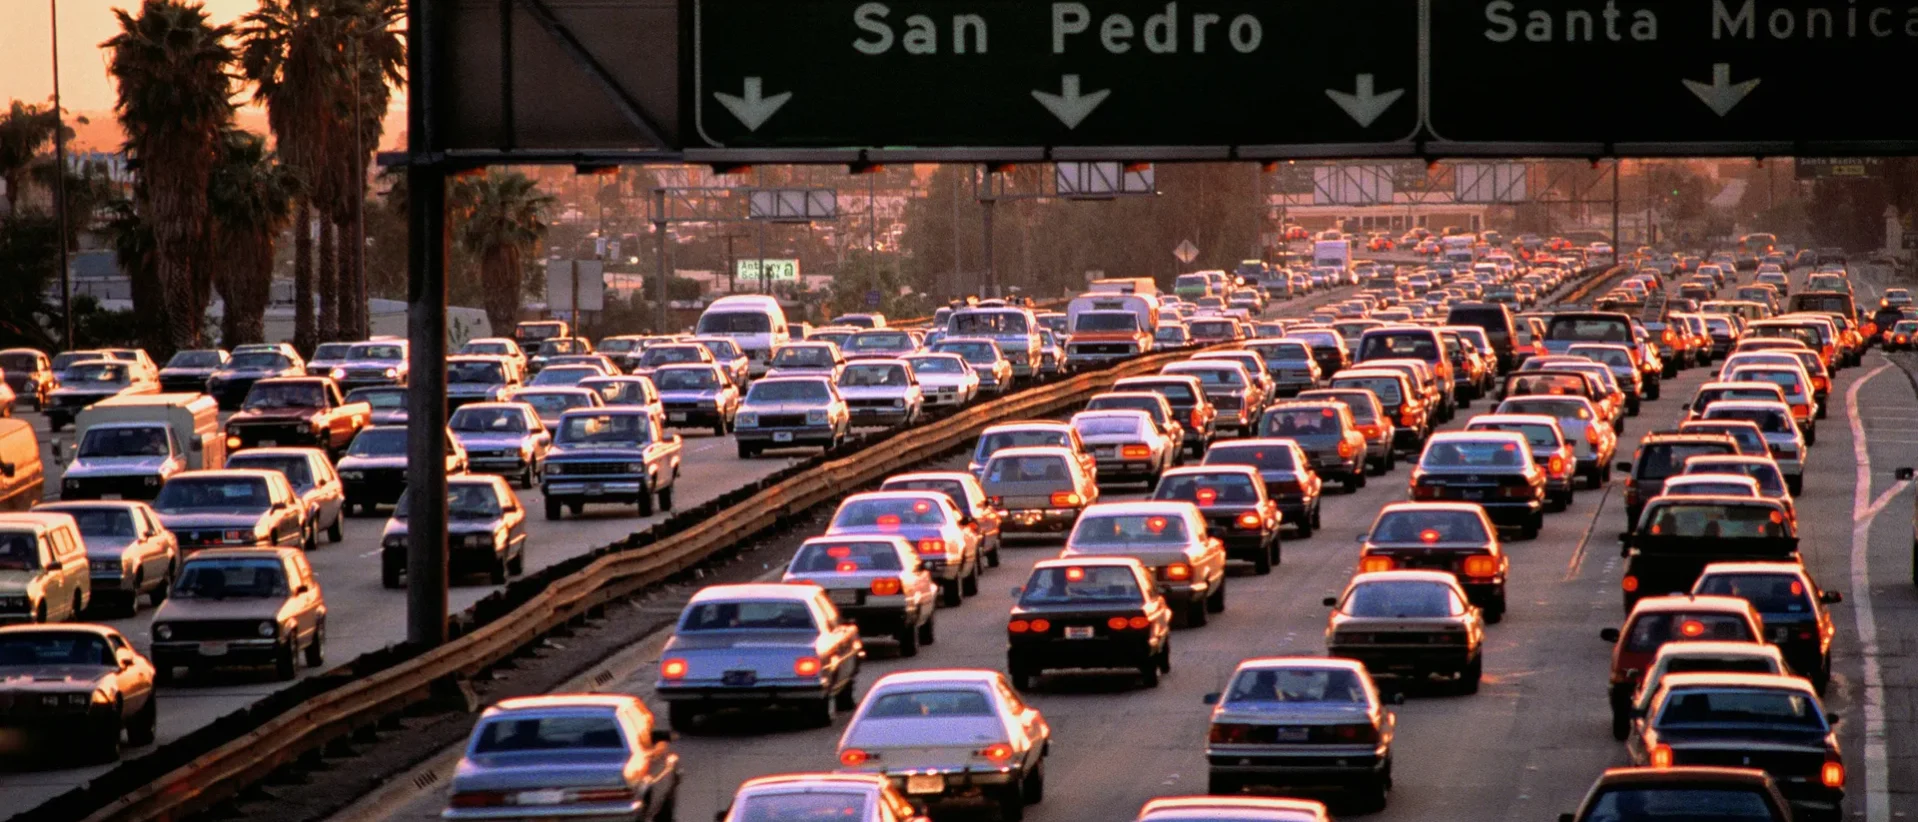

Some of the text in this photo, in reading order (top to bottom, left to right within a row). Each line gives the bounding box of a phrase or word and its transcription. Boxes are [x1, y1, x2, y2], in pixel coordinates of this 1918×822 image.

[853, 1, 1263, 54] San Pedro
[1484, 0, 1657, 42] Santa
[741, 261, 781, 271] Antony
